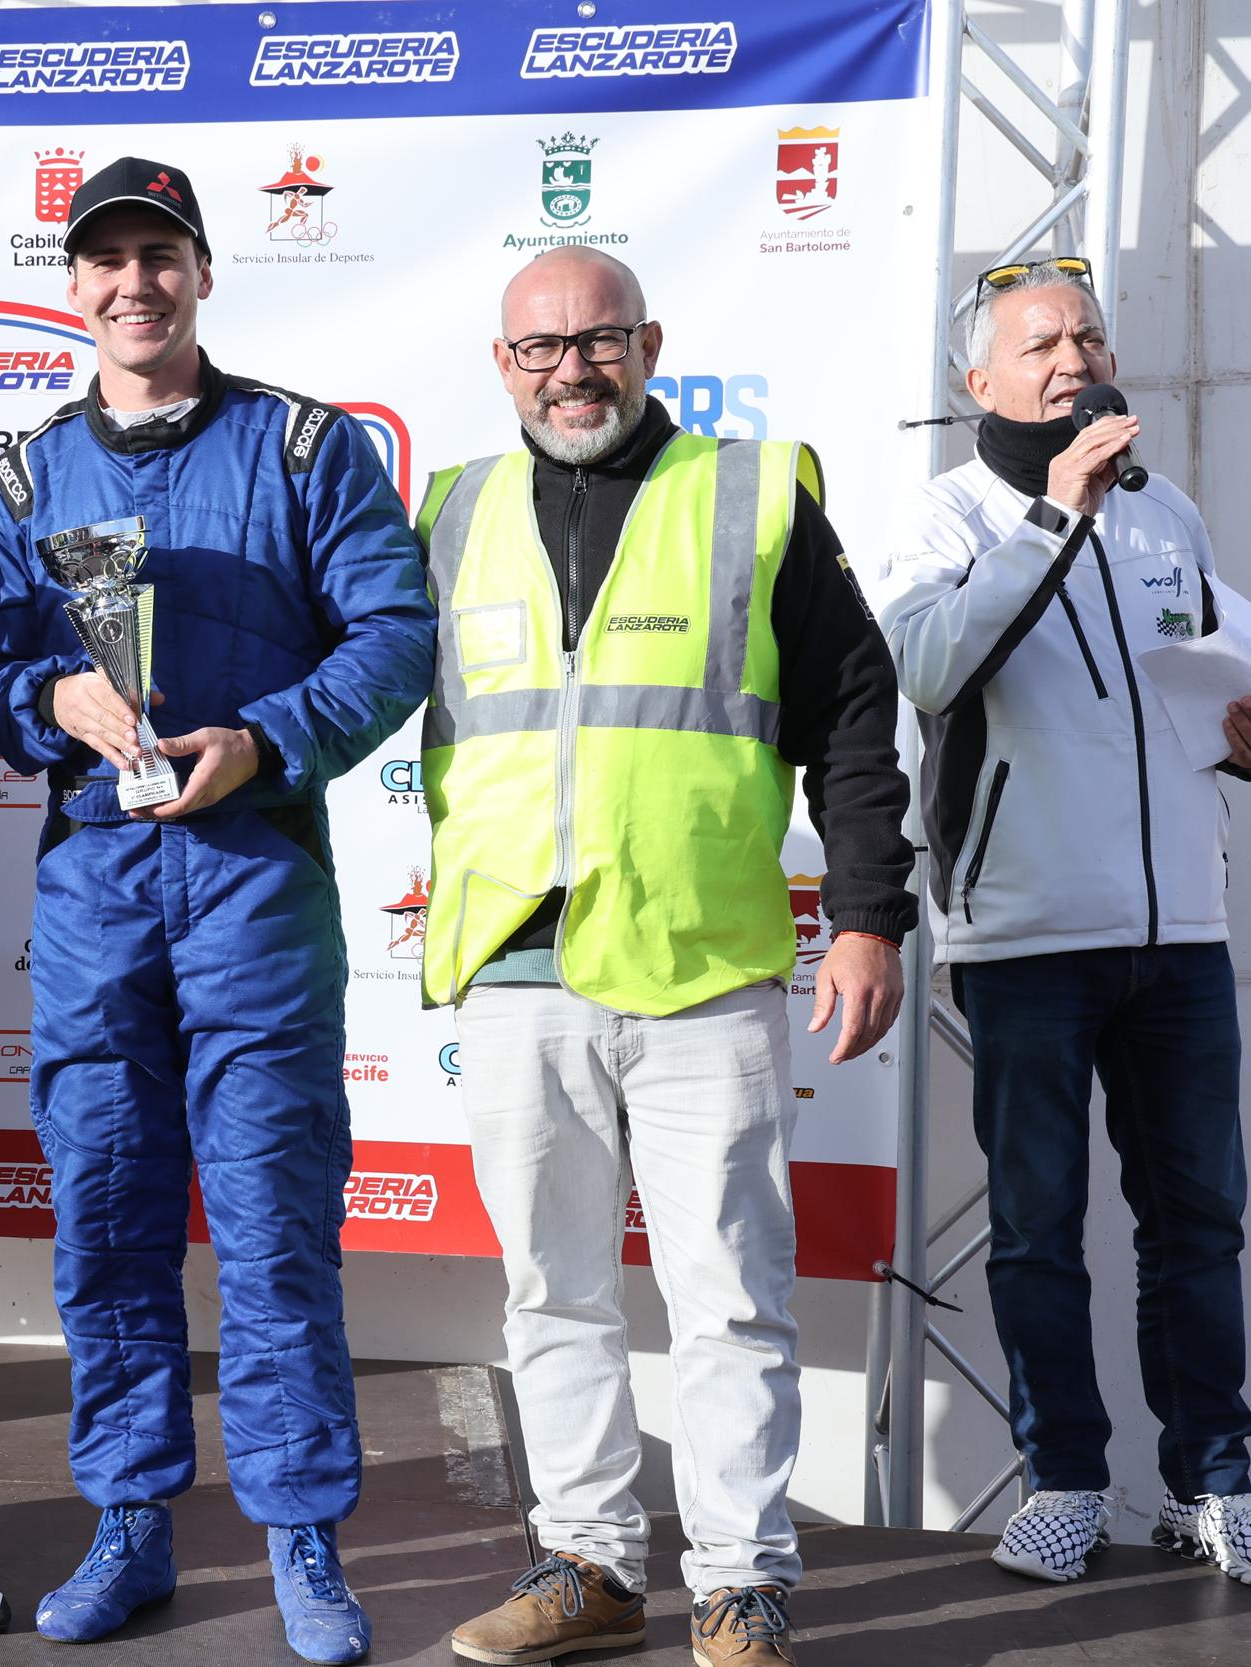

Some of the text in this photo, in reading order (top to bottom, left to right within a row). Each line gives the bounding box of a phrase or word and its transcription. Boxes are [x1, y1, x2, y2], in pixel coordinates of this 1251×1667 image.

[532, 27, 733, 53] ESCUDERIA
[260, 37, 455, 61] ESCUDERIA
[525, 49, 731, 74] LANZAROTE
[254, 58, 453, 81] LANZAROTE
[10, 234, 62, 249] Cabil
[503, 231, 629, 251] Ayuntamiento
[760, 227, 851, 242] Ayuntamiento de
[760, 240, 851, 253] San Bartolomé
[14, 252, 67, 267] Lanza
[232, 252, 375, 264] Servicio Insular de Deportes
[293, 408, 328, 458] sparco
[1140, 567, 1182, 597] wolf
[607, 623, 689, 632] LANZAROTE
[609, 616, 689, 625] ESCUDERIA
[353, 969, 422, 981] Servicio Insul
[345, 1053, 389, 1063] ERVICIO
[343, 1065, 389, 1082] ecife
